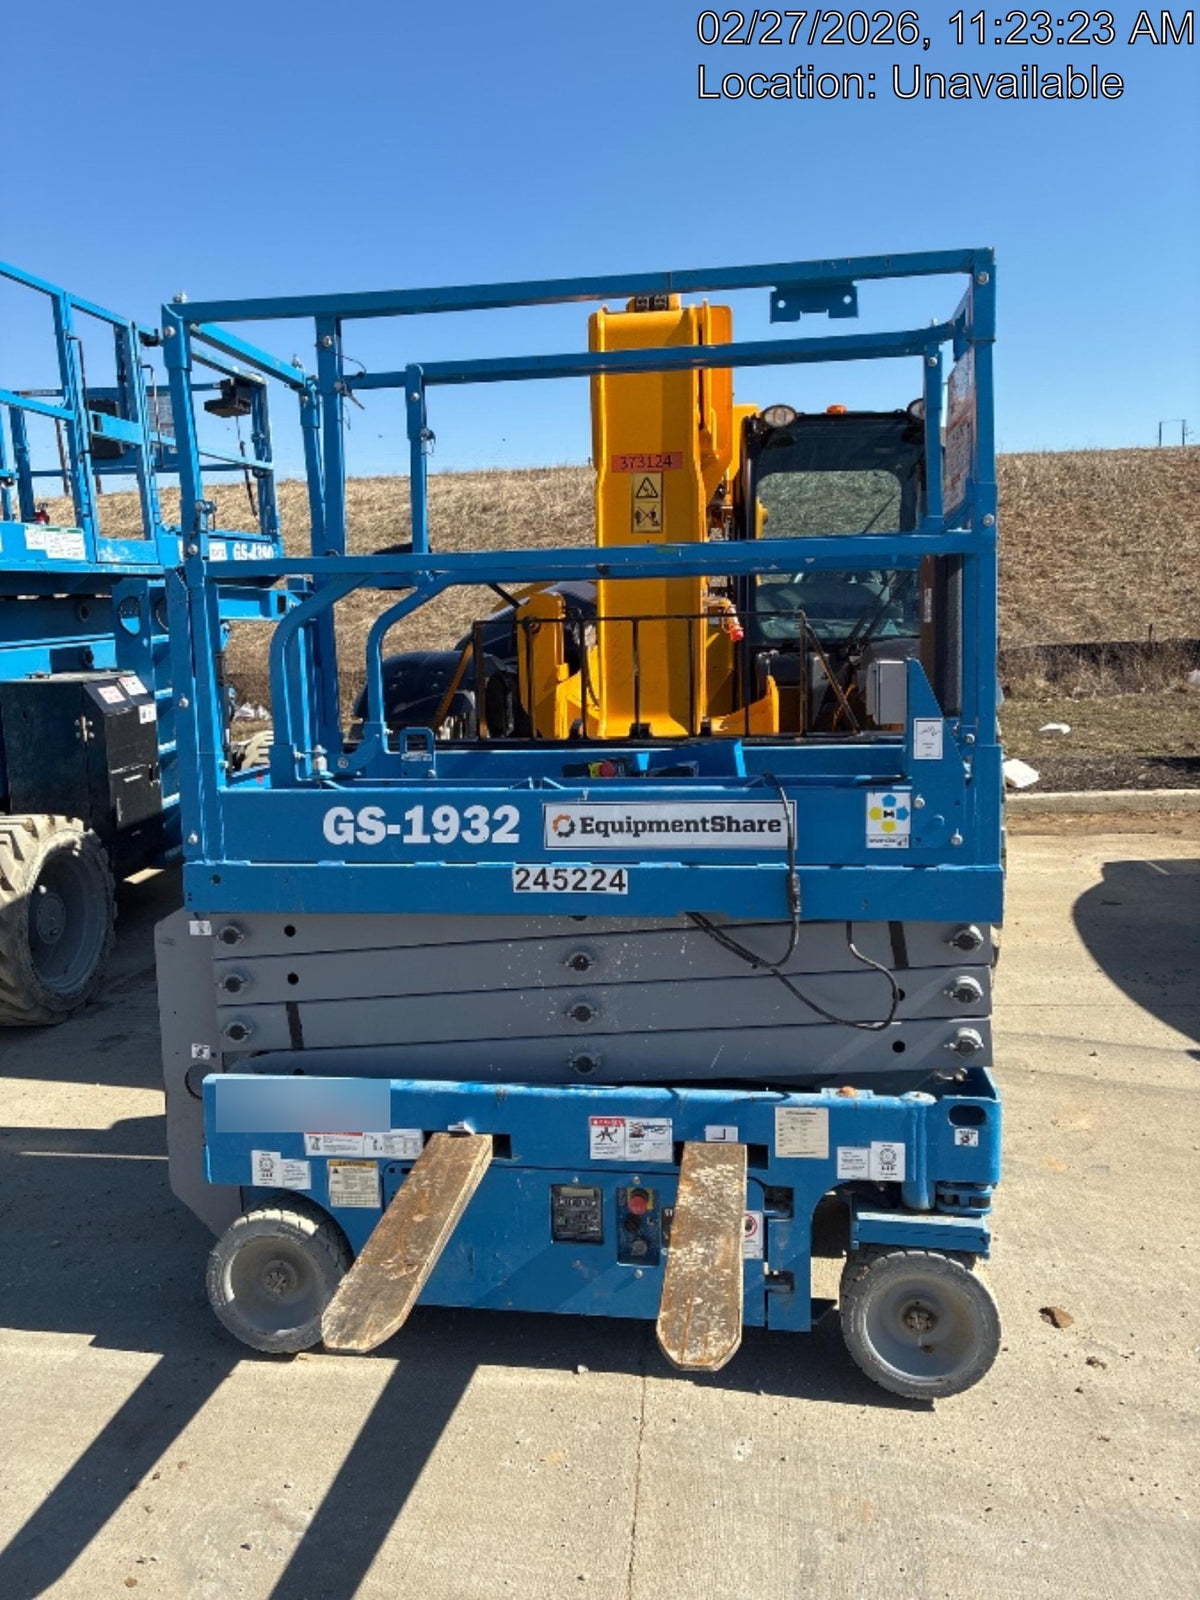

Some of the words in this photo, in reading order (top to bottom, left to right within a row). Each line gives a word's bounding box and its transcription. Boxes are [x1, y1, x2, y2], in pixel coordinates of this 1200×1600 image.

[620, 454, 673, 470] 373124
[323, 805, 520, 845] GS-1932
[580, 815, 783, 839] EquipmentShare
[514, 867, 627, 893] 245224
